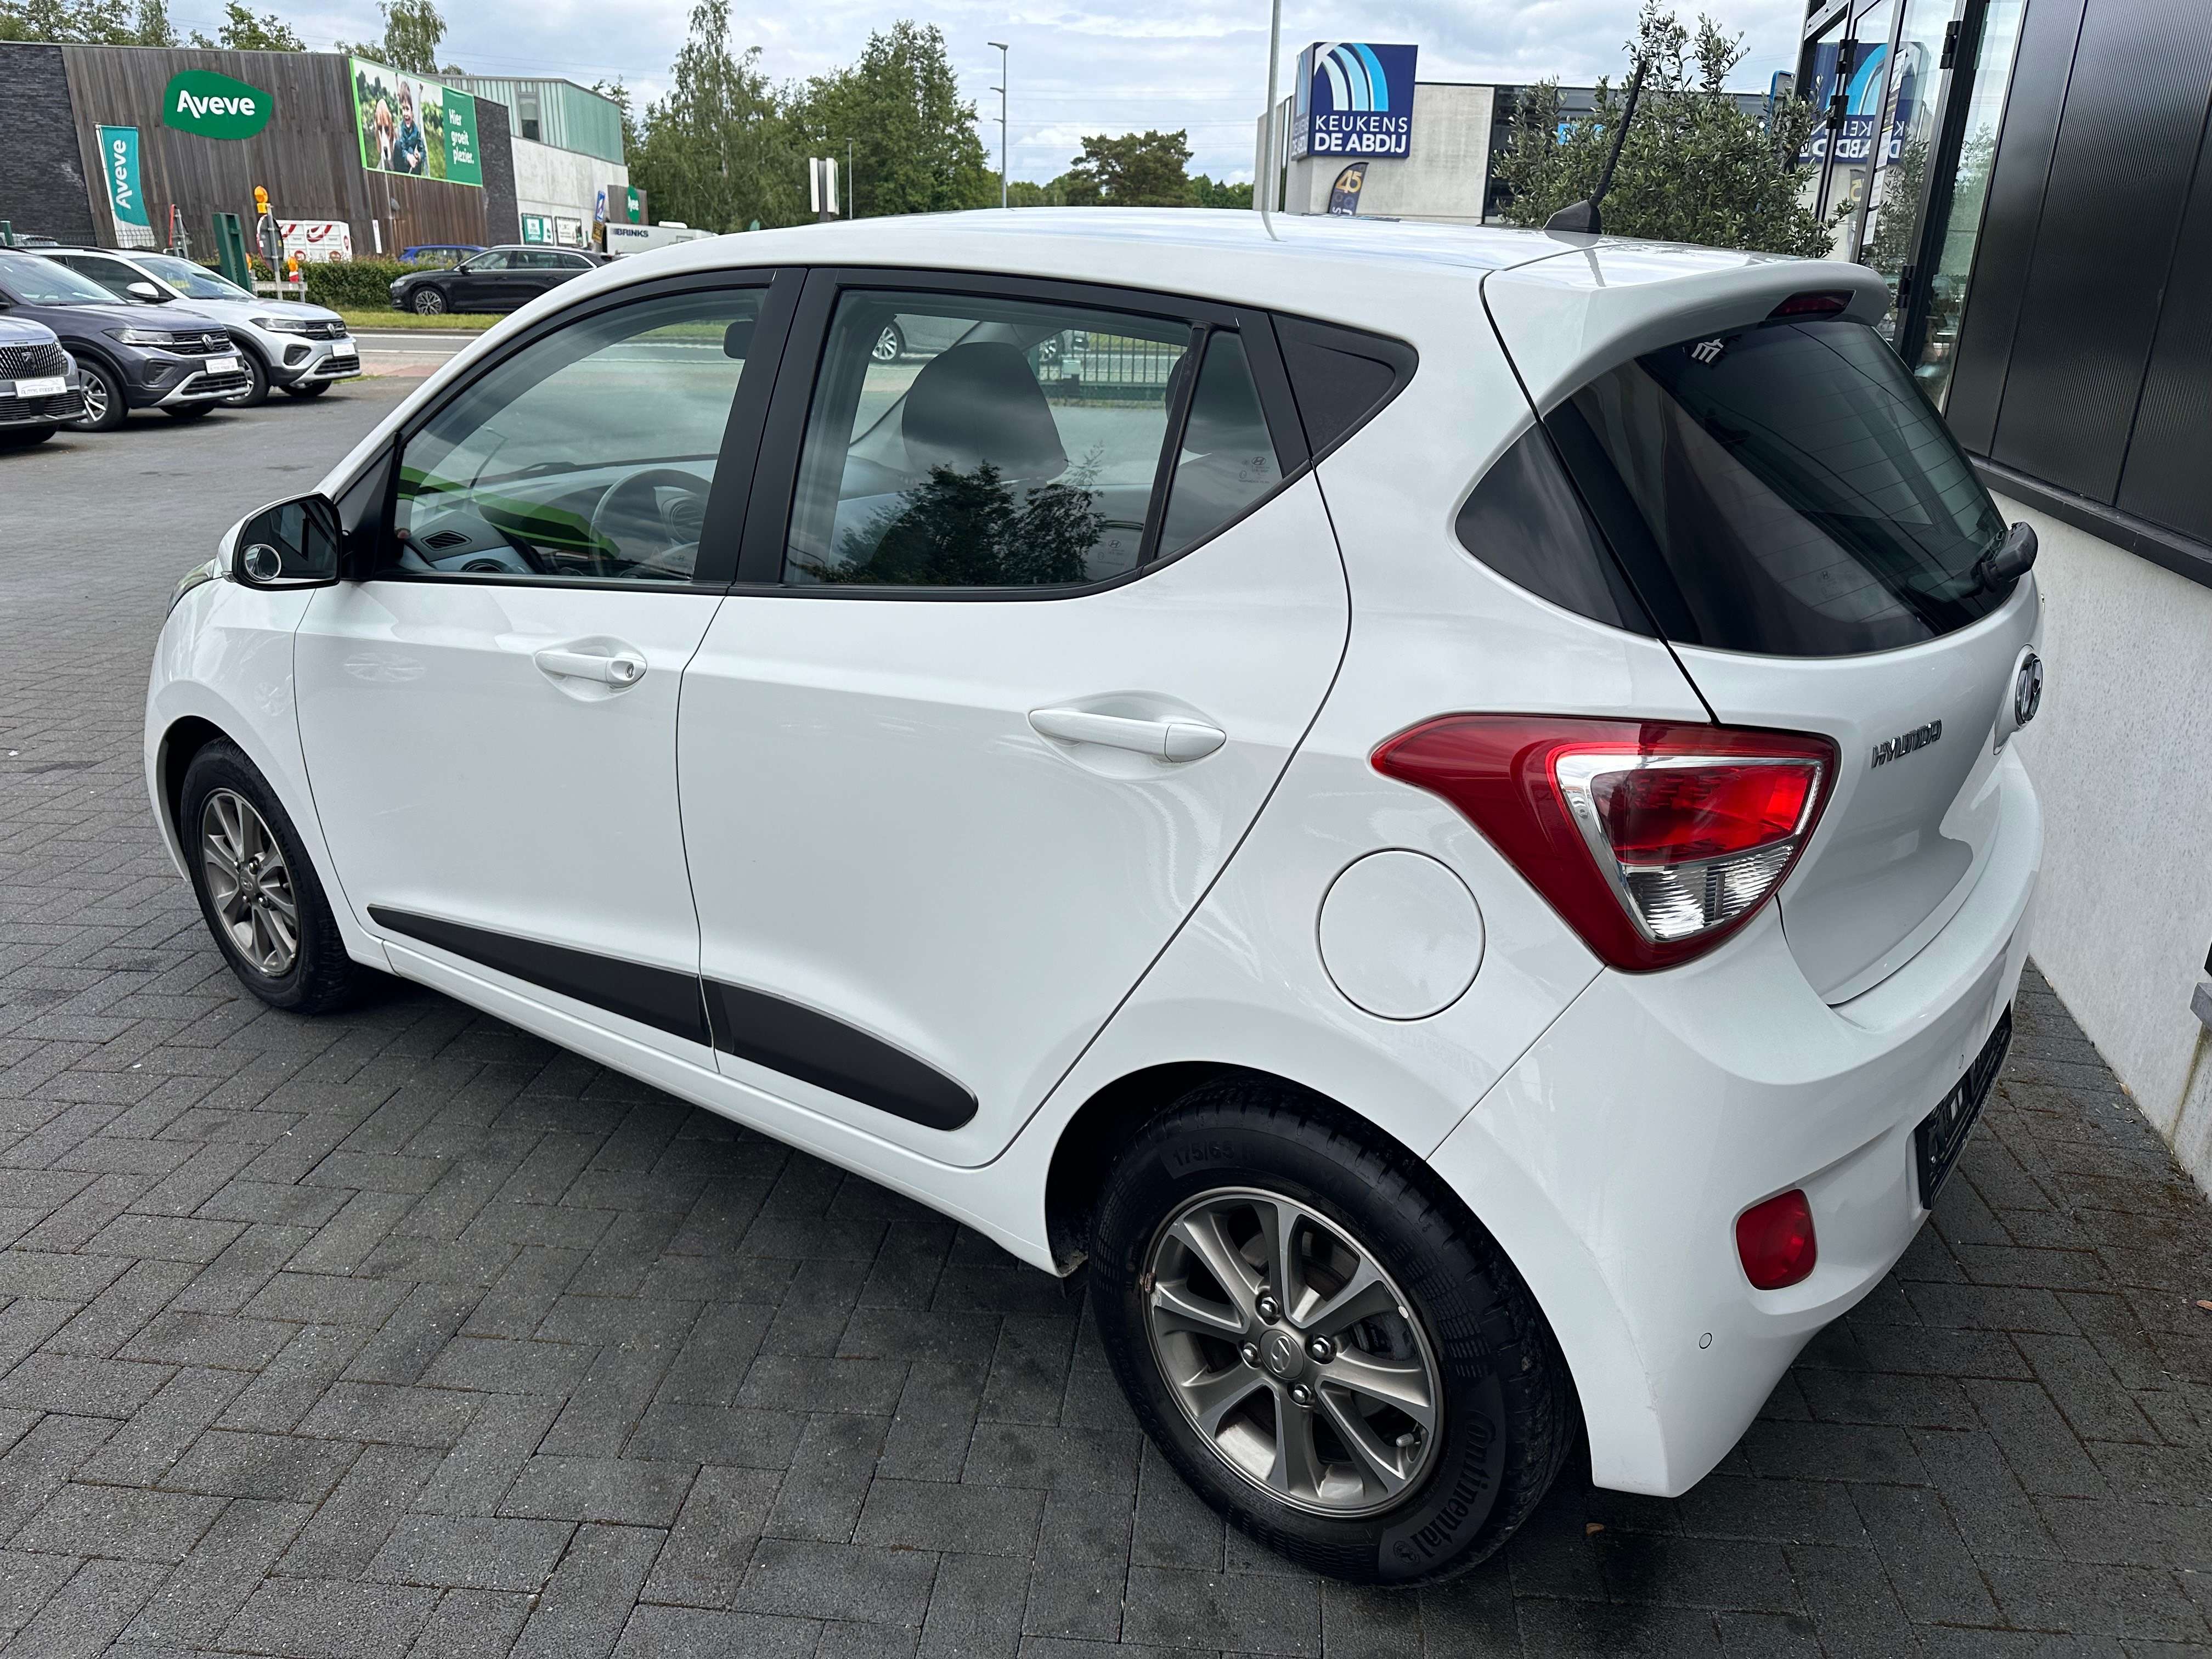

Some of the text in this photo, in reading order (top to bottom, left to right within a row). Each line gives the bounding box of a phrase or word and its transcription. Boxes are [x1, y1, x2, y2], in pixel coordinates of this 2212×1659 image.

[177, 90, 255, 119] Aveve
[449, 108, 461, 126] Hier
[1315, 115, 1408, 133] KEUKENS
[451, 130, 469, 146] groeit
[1314, 132, 1343, 151] DE
[1345, 133, 1406, 153] ABDIJ
[113, 139, 133, 210] Aveve
[1335, 170, 1362, 193] 45
[1871, 719, 1942, 768] HYUNDAI
[1173, 1139, 1235, 1166] 175/65
[1410, 1408, 1497, 1559] Continental
